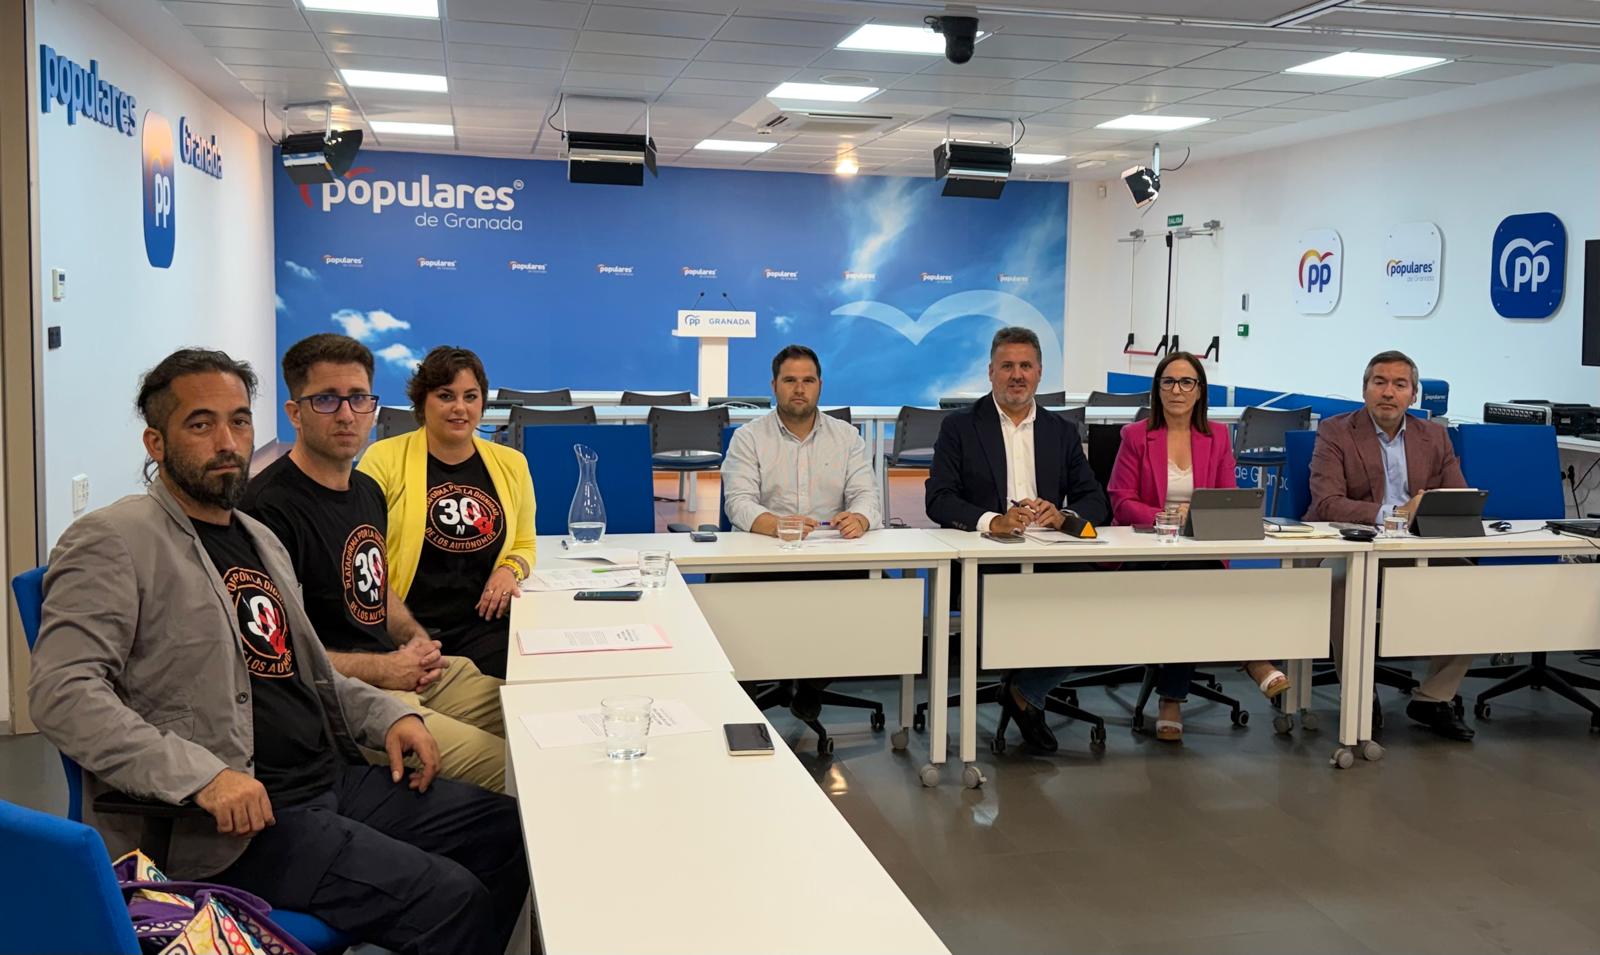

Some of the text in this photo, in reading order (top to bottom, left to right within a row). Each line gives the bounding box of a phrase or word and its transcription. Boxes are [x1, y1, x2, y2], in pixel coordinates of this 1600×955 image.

[40, 44, 137, 137] populares
[180, 116, 223, 179] Granada
[415, 212, 523, 231] de Granada
[326, 256, 362, 265] populares
[420, 259, 456, 268] populares
[512, 262, 545, 270] populares
[599, 265, 632, 273] populares
[1390, 261, 1433, 277] populares
[1513, 255, 1550, 293] pp
[1307, 263, 1331, 293] pp
[709, 317, 751, 325] GRANADA
[438, 497, 482, 526] 30
[456, 525, 465, 535] N
[432, 534, 449, 547] LOS
[355, 547, 384, 592] 30
[370, 588, 379, 602] N
